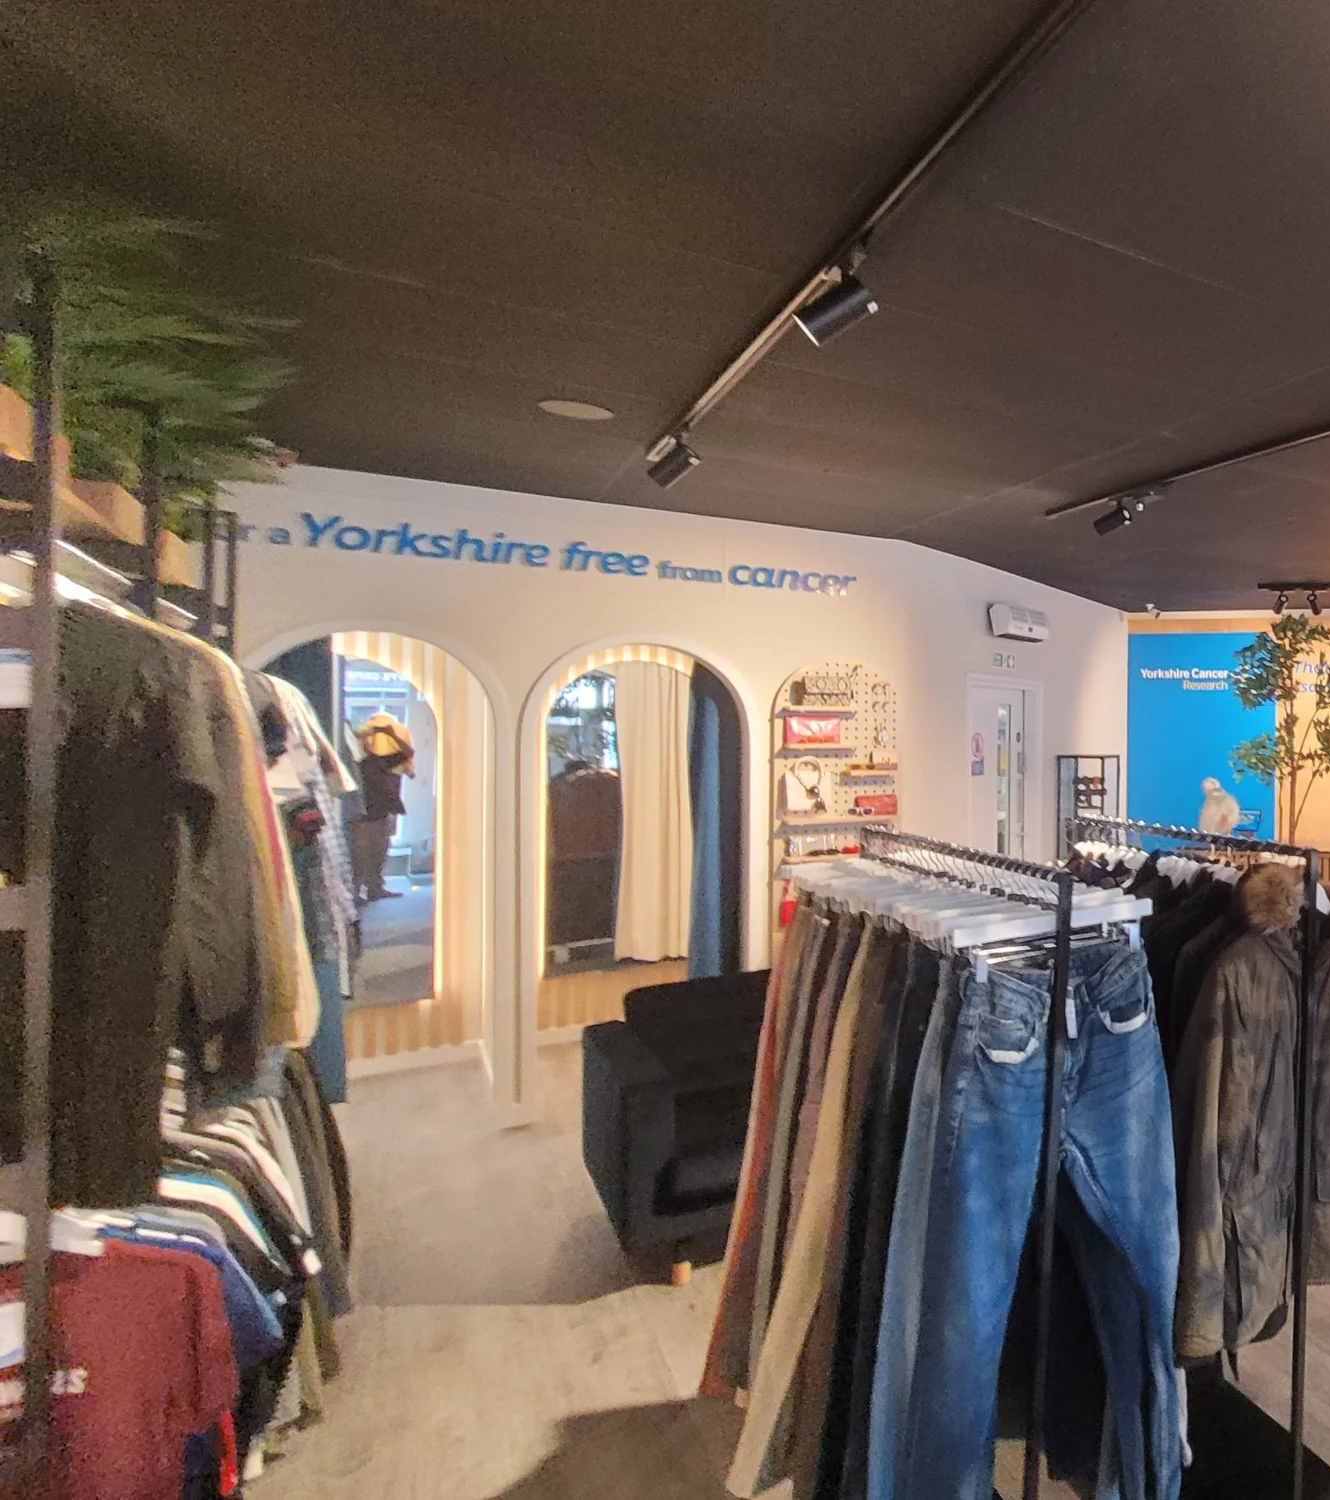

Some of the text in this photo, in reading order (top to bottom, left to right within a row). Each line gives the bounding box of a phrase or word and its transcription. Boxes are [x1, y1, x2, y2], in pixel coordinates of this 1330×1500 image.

[267, 525, 291, 545] a
[300, 511, 550, 567] Yorkshire
[560, 541, 650, 576] free
[655, 560, 723, 583] from
[728, 564, 857, 596] cancer
[1140, 667, 1229, 679] Yorkshire Cancer
[1182, 680, 1229, 691] Research
